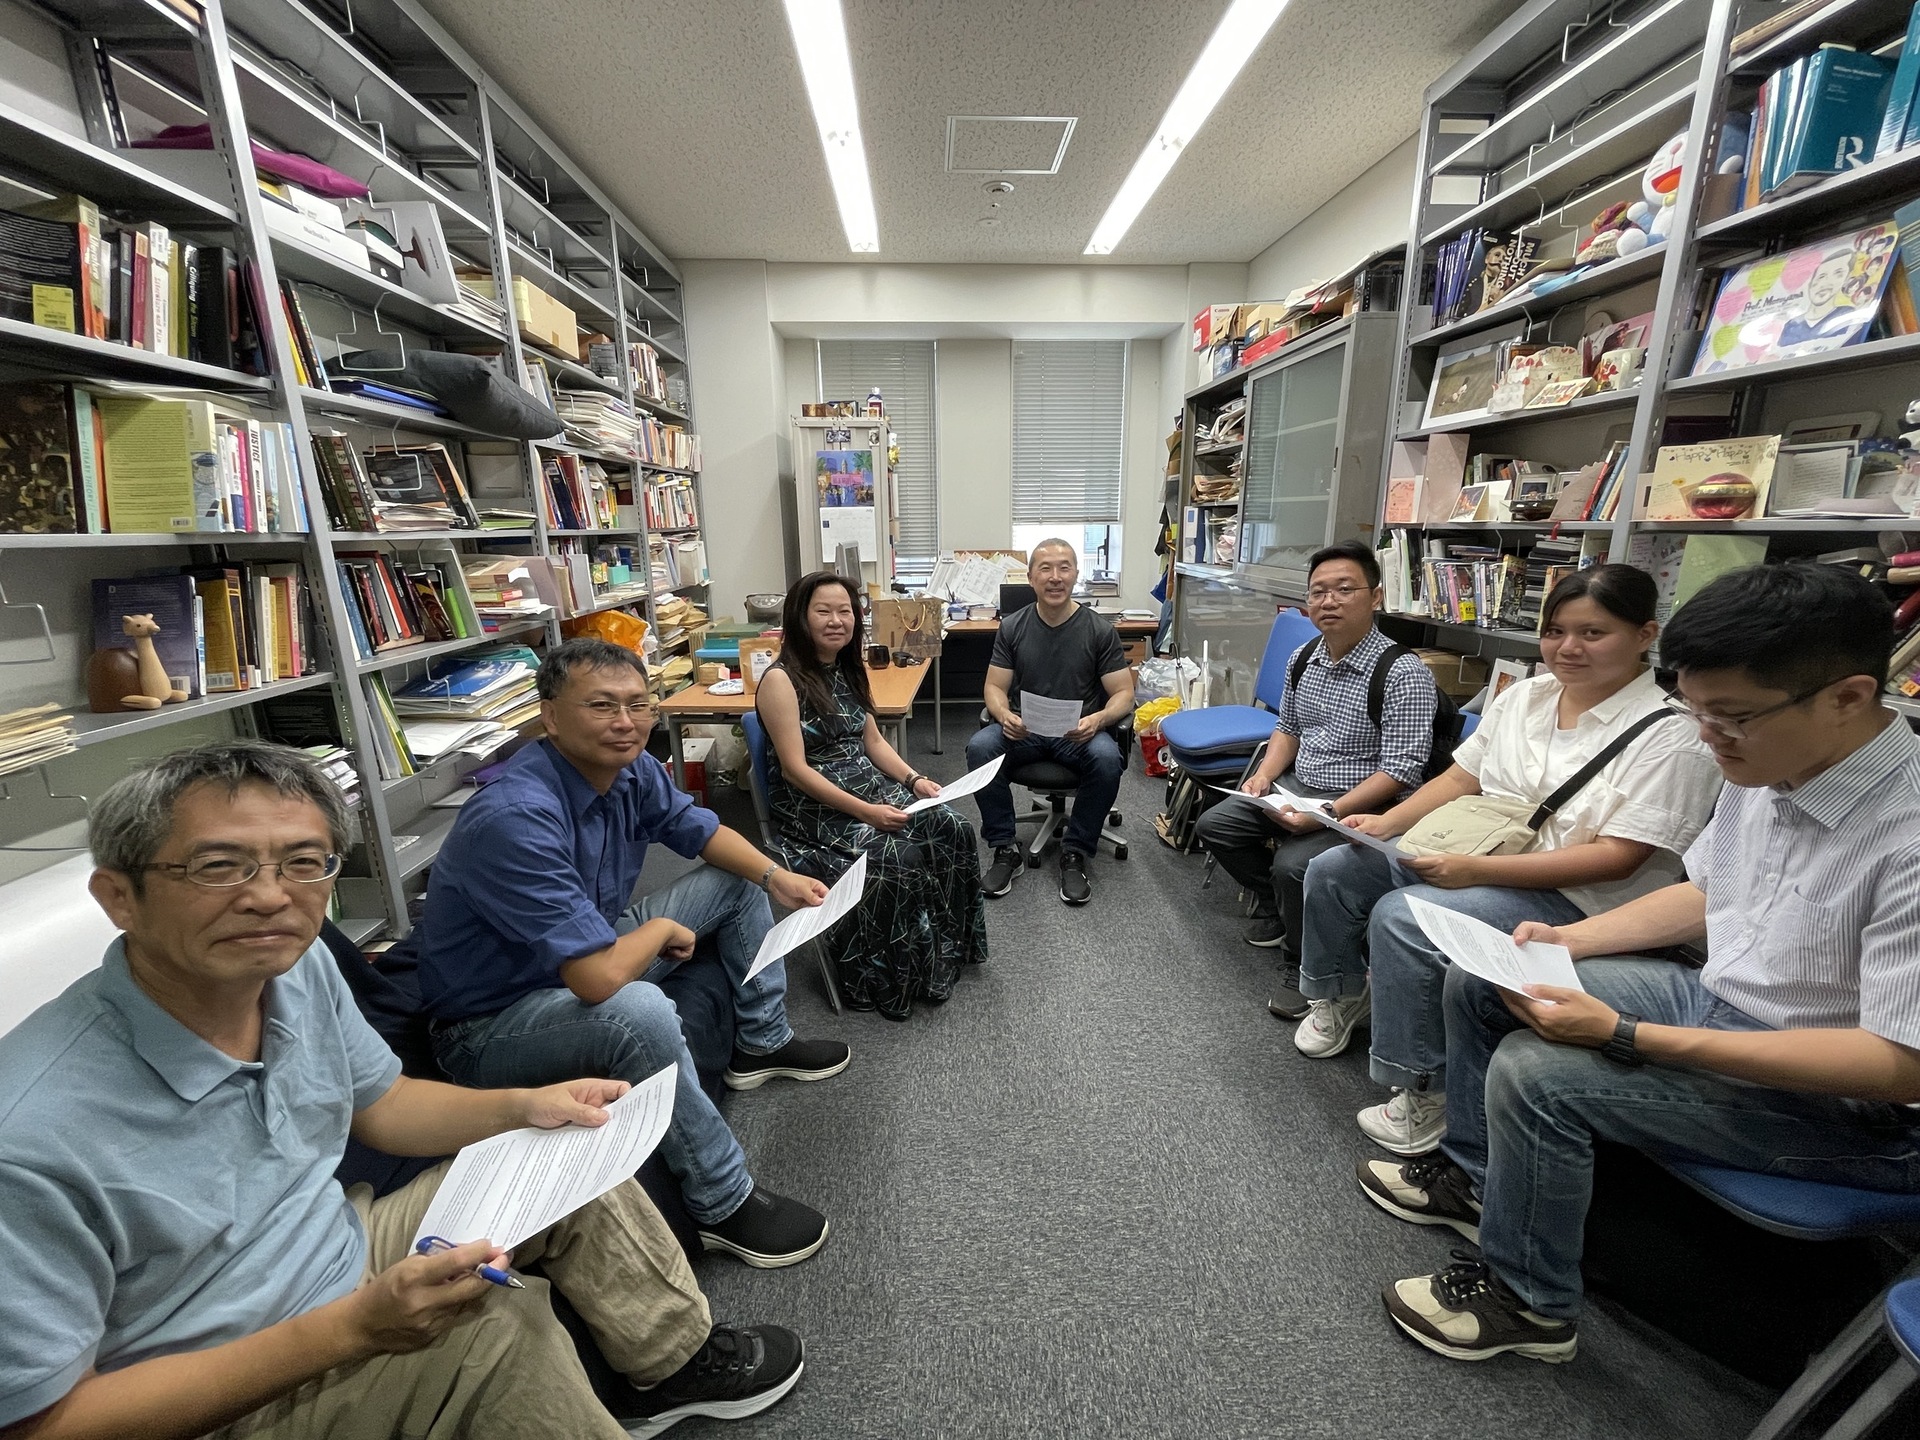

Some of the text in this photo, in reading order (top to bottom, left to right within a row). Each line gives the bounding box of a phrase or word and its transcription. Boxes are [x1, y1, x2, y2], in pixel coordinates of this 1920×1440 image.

[1497, 239, 1518, 288] NOTHING
[1517, 242, 1535, 277] MUCH
[154, 277, 162, 313] Literature
[189, 266, 198, 301] Critiquing
[190, 315, 198, 338] Sitcom
[81, 441, 91, 474] LITERARY
[250, 429, 260, 463] JUSTICE
[1675, 447, 1751, 463] Happy Happy
[85, 475, 94, 503] THEORY
